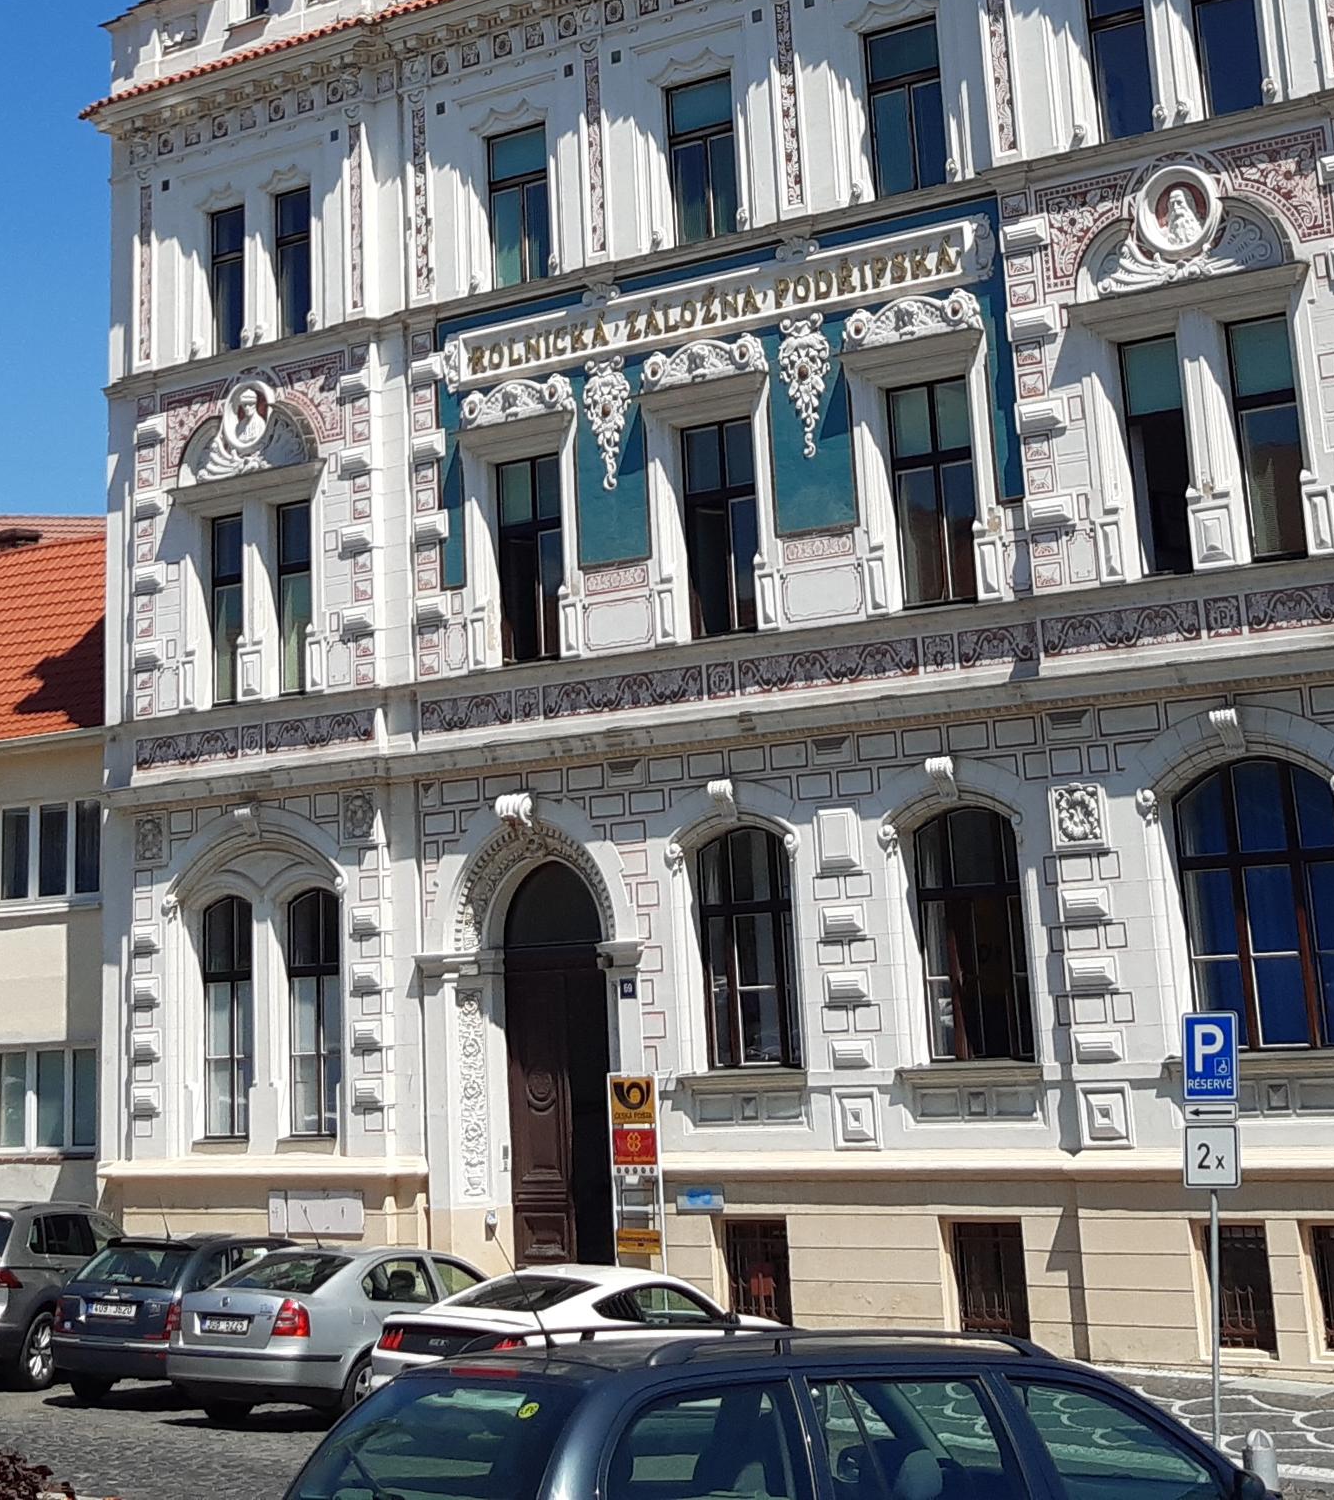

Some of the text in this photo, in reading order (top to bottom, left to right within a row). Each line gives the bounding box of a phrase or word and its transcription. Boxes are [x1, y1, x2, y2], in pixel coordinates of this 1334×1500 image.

[468, 235, 957, 375] ROLNICKÁ ZÁLOŽNA PODŘIPSKÁ
[1194, 1024, 1224, 1073] P
[1188, 1078, 1232, 1090] RÉSERVÉ
[1197, 1143, 1225, 1170] 2 x
